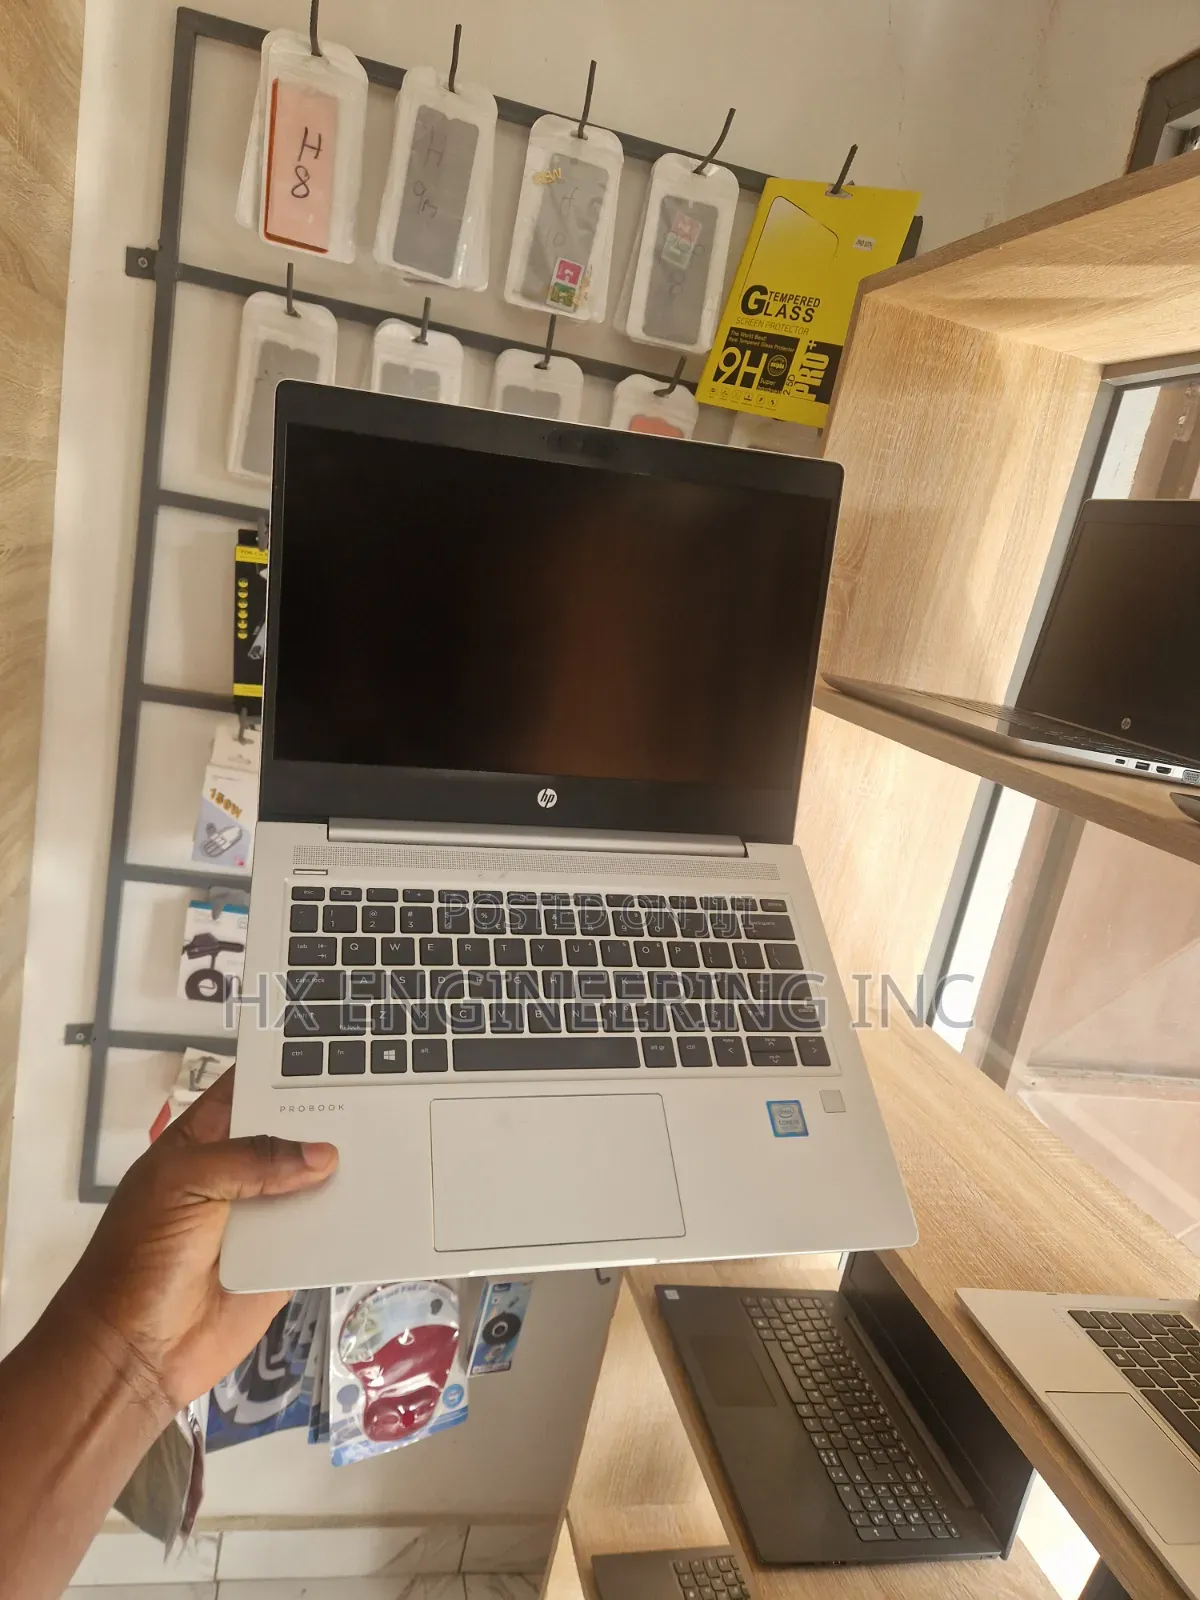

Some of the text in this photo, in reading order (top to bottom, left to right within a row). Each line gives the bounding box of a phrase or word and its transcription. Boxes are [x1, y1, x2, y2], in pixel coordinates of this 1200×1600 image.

[291, 165, 311, 199] 8
[741, 285, 815, 323] GLASS
[769, 291, 821, 308] TEMPERED
[736, 317, 810, 336] SCREEN PROTECTOR
[741, 331, 754, 340] World
[717, 346, 768, 390] 9H
[537, 788, 558, 809] hp
[279, 1104, 345, 1113] PROBOOK
